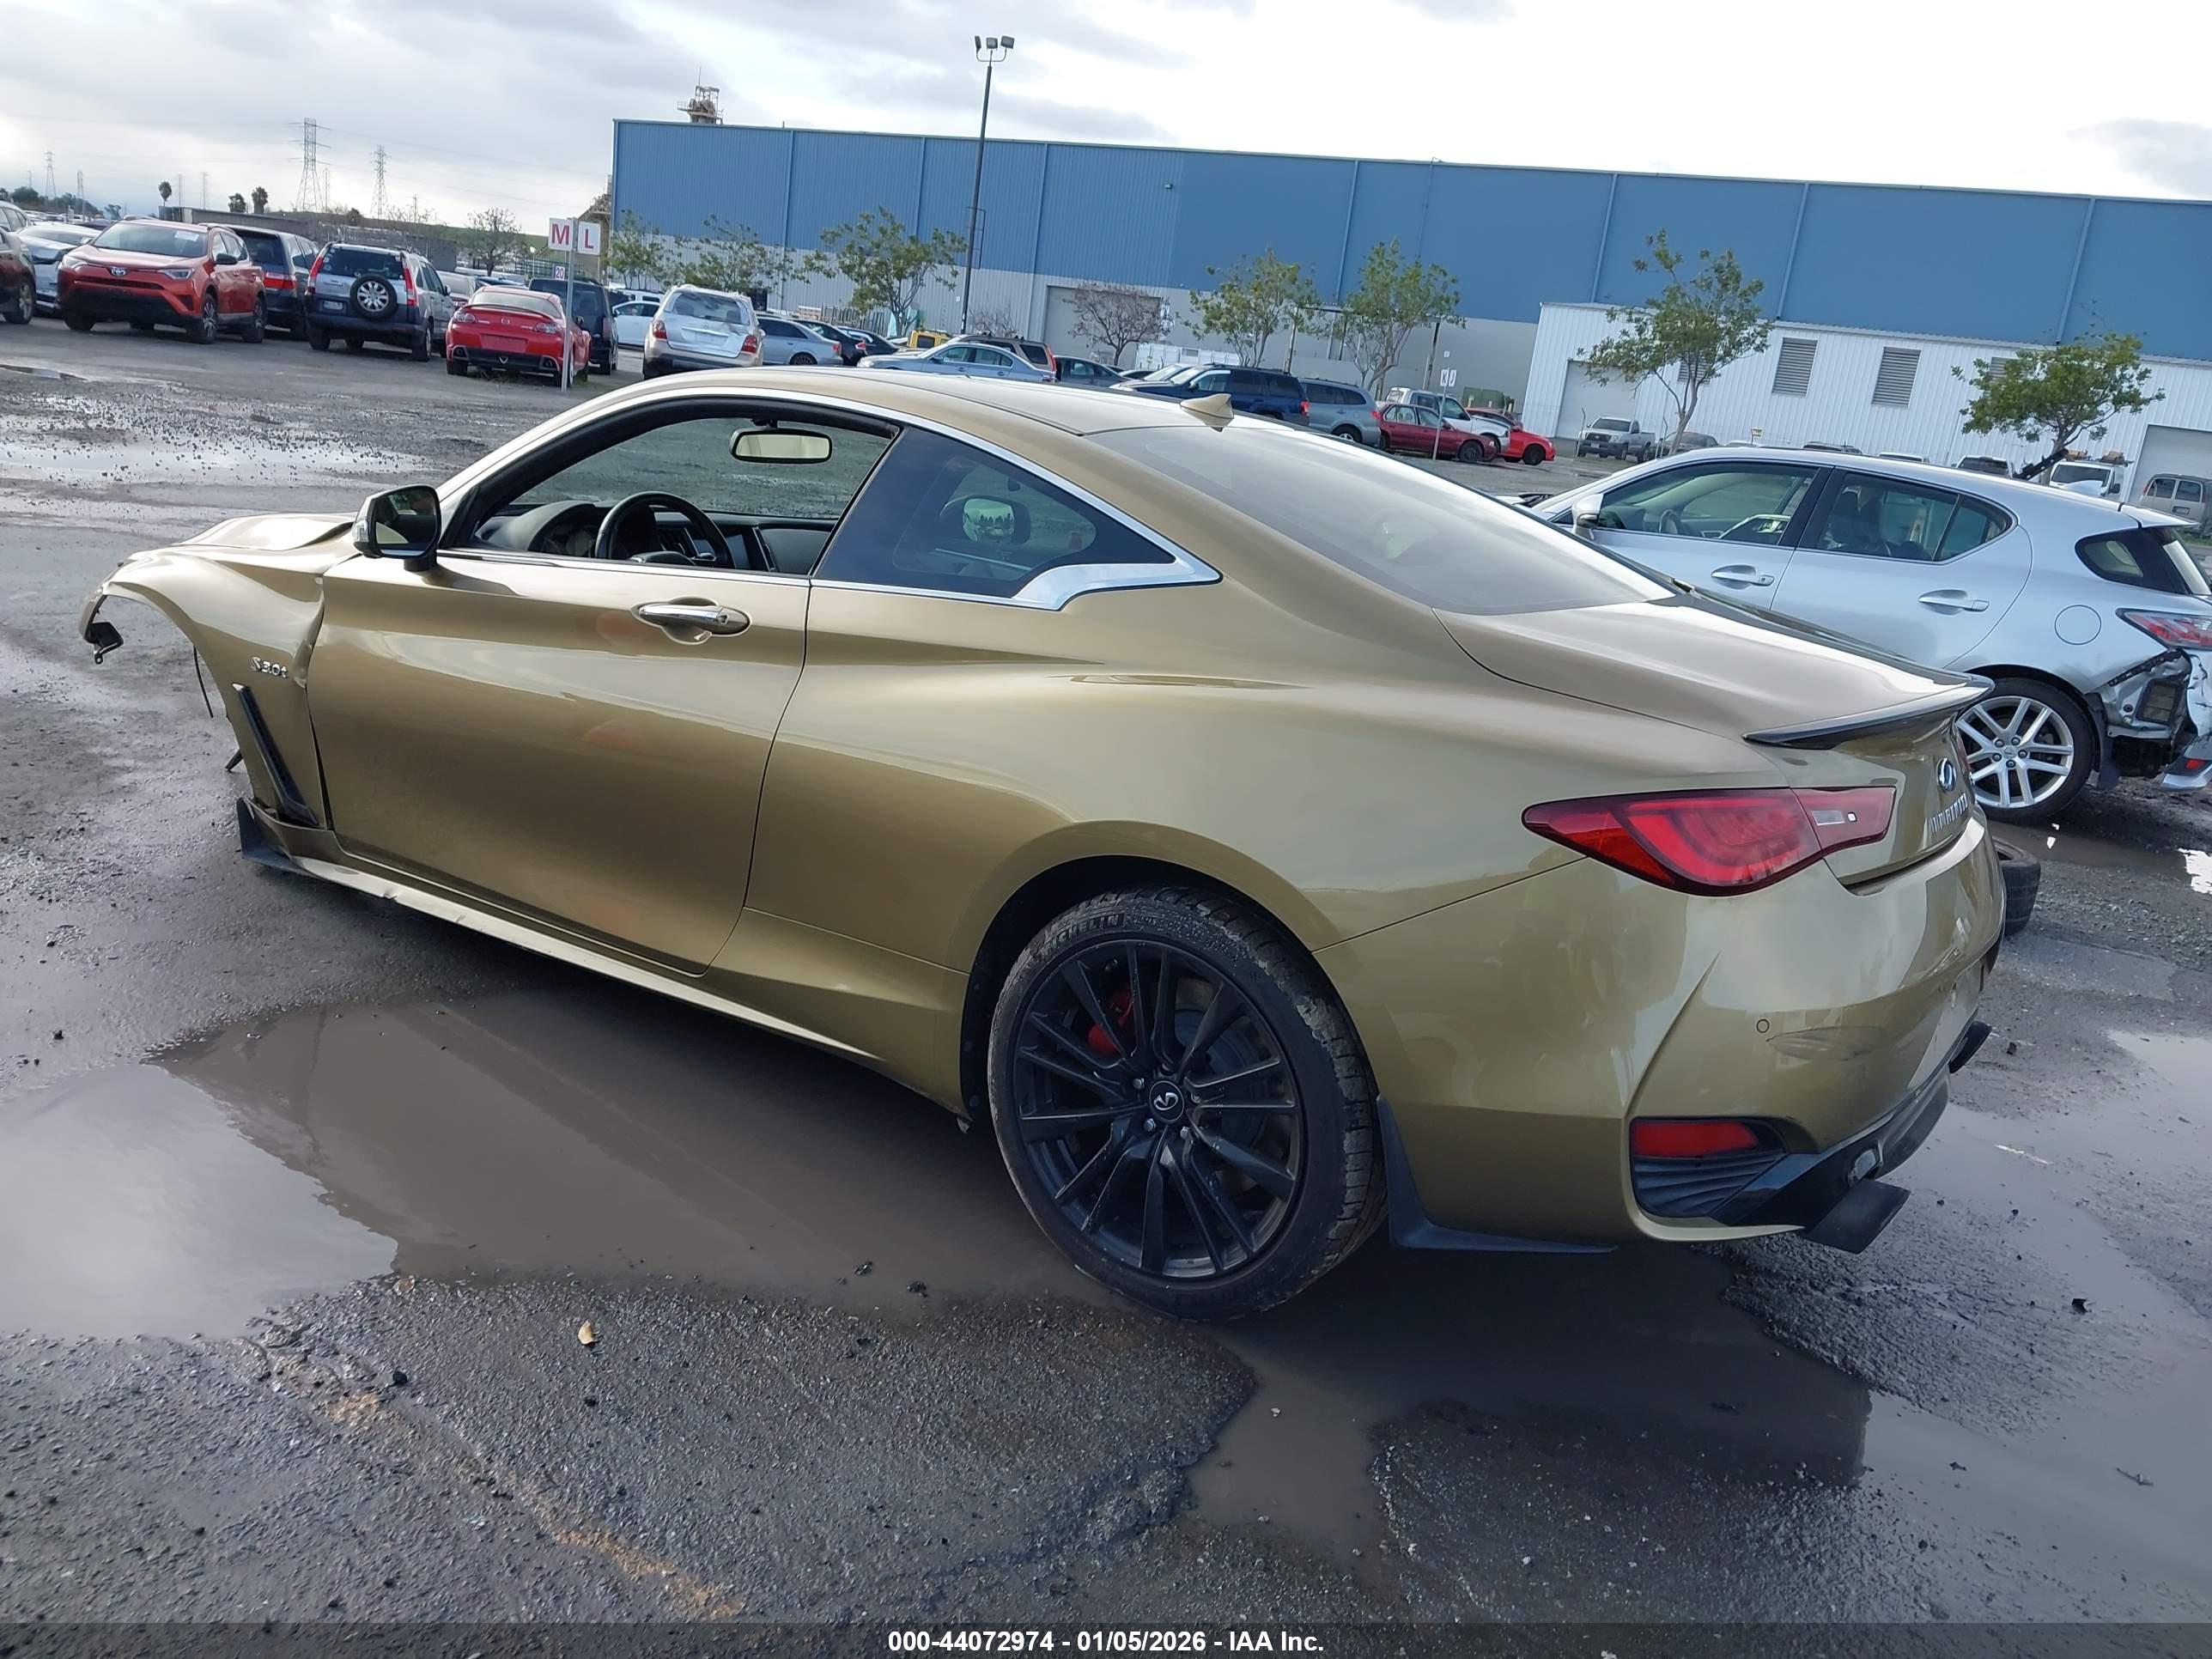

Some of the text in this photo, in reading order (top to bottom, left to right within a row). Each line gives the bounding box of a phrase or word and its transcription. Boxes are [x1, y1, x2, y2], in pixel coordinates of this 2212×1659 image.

[551, 223, 570, 246] M
[585, 228, 594, 249] L
[556, 267, 564, 279] 20
